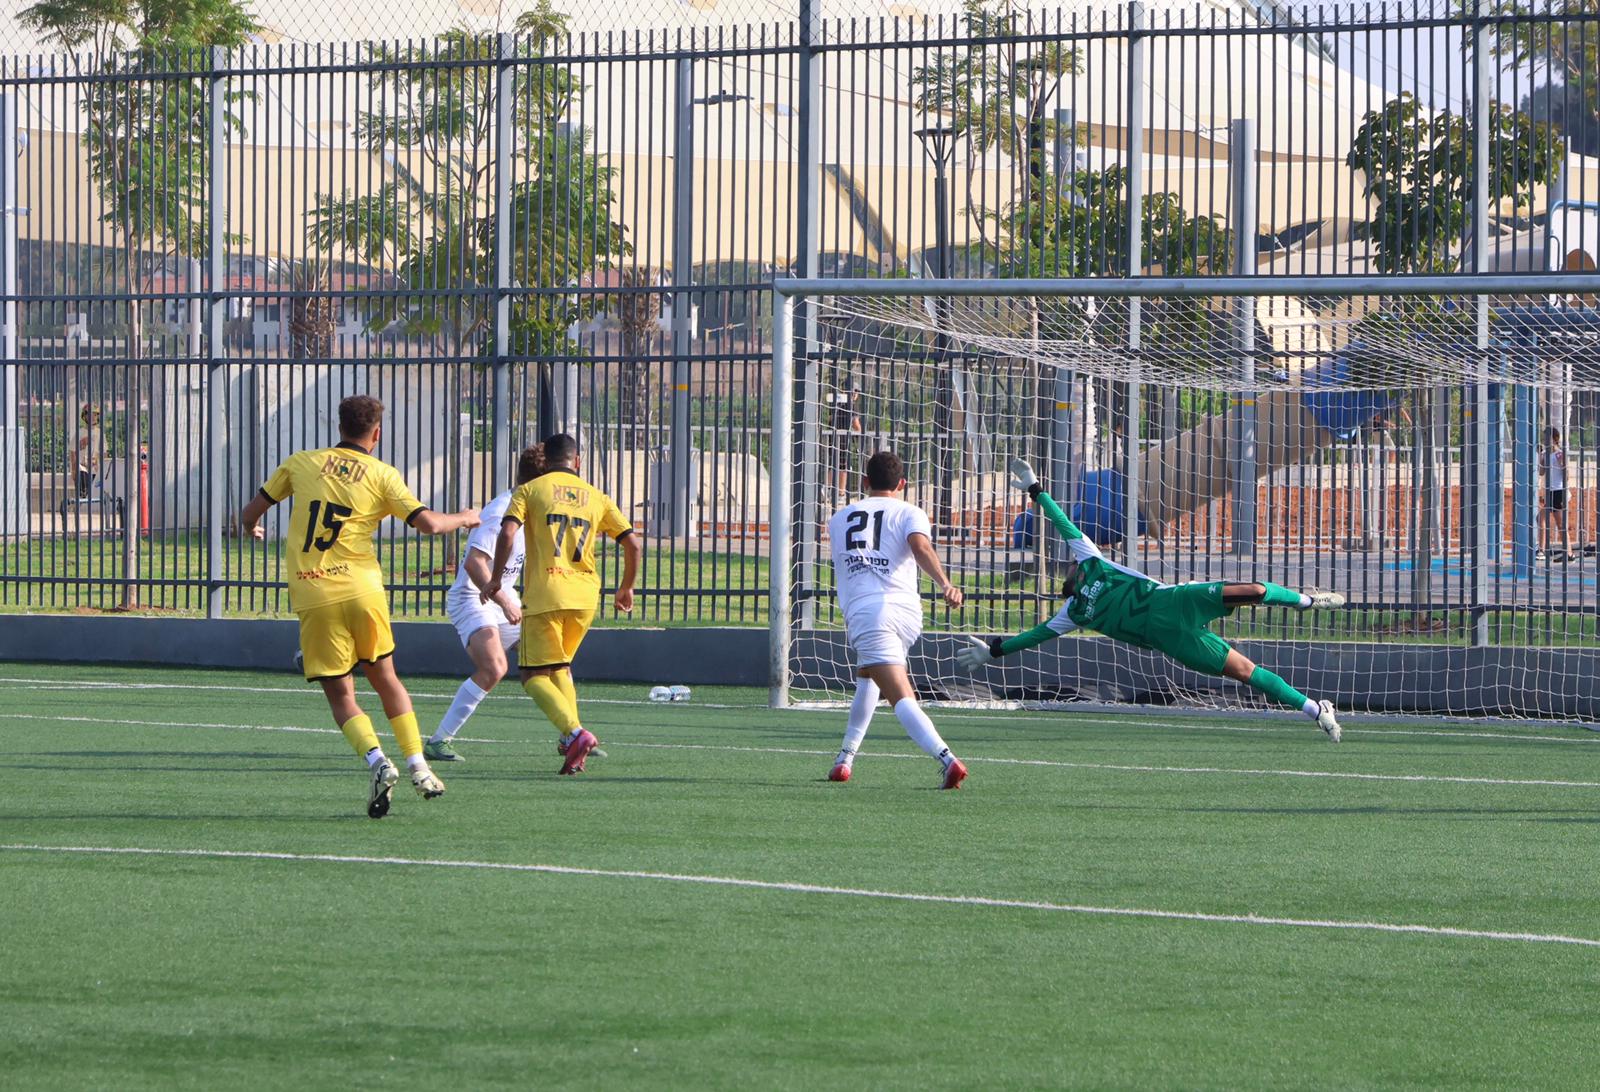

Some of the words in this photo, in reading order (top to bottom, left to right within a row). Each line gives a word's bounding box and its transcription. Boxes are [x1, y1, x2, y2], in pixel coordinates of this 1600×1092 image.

[303, 499, 353, 553] 15
[546, 513, 591, 562] 77
[846, 510, 885, 552] 21
